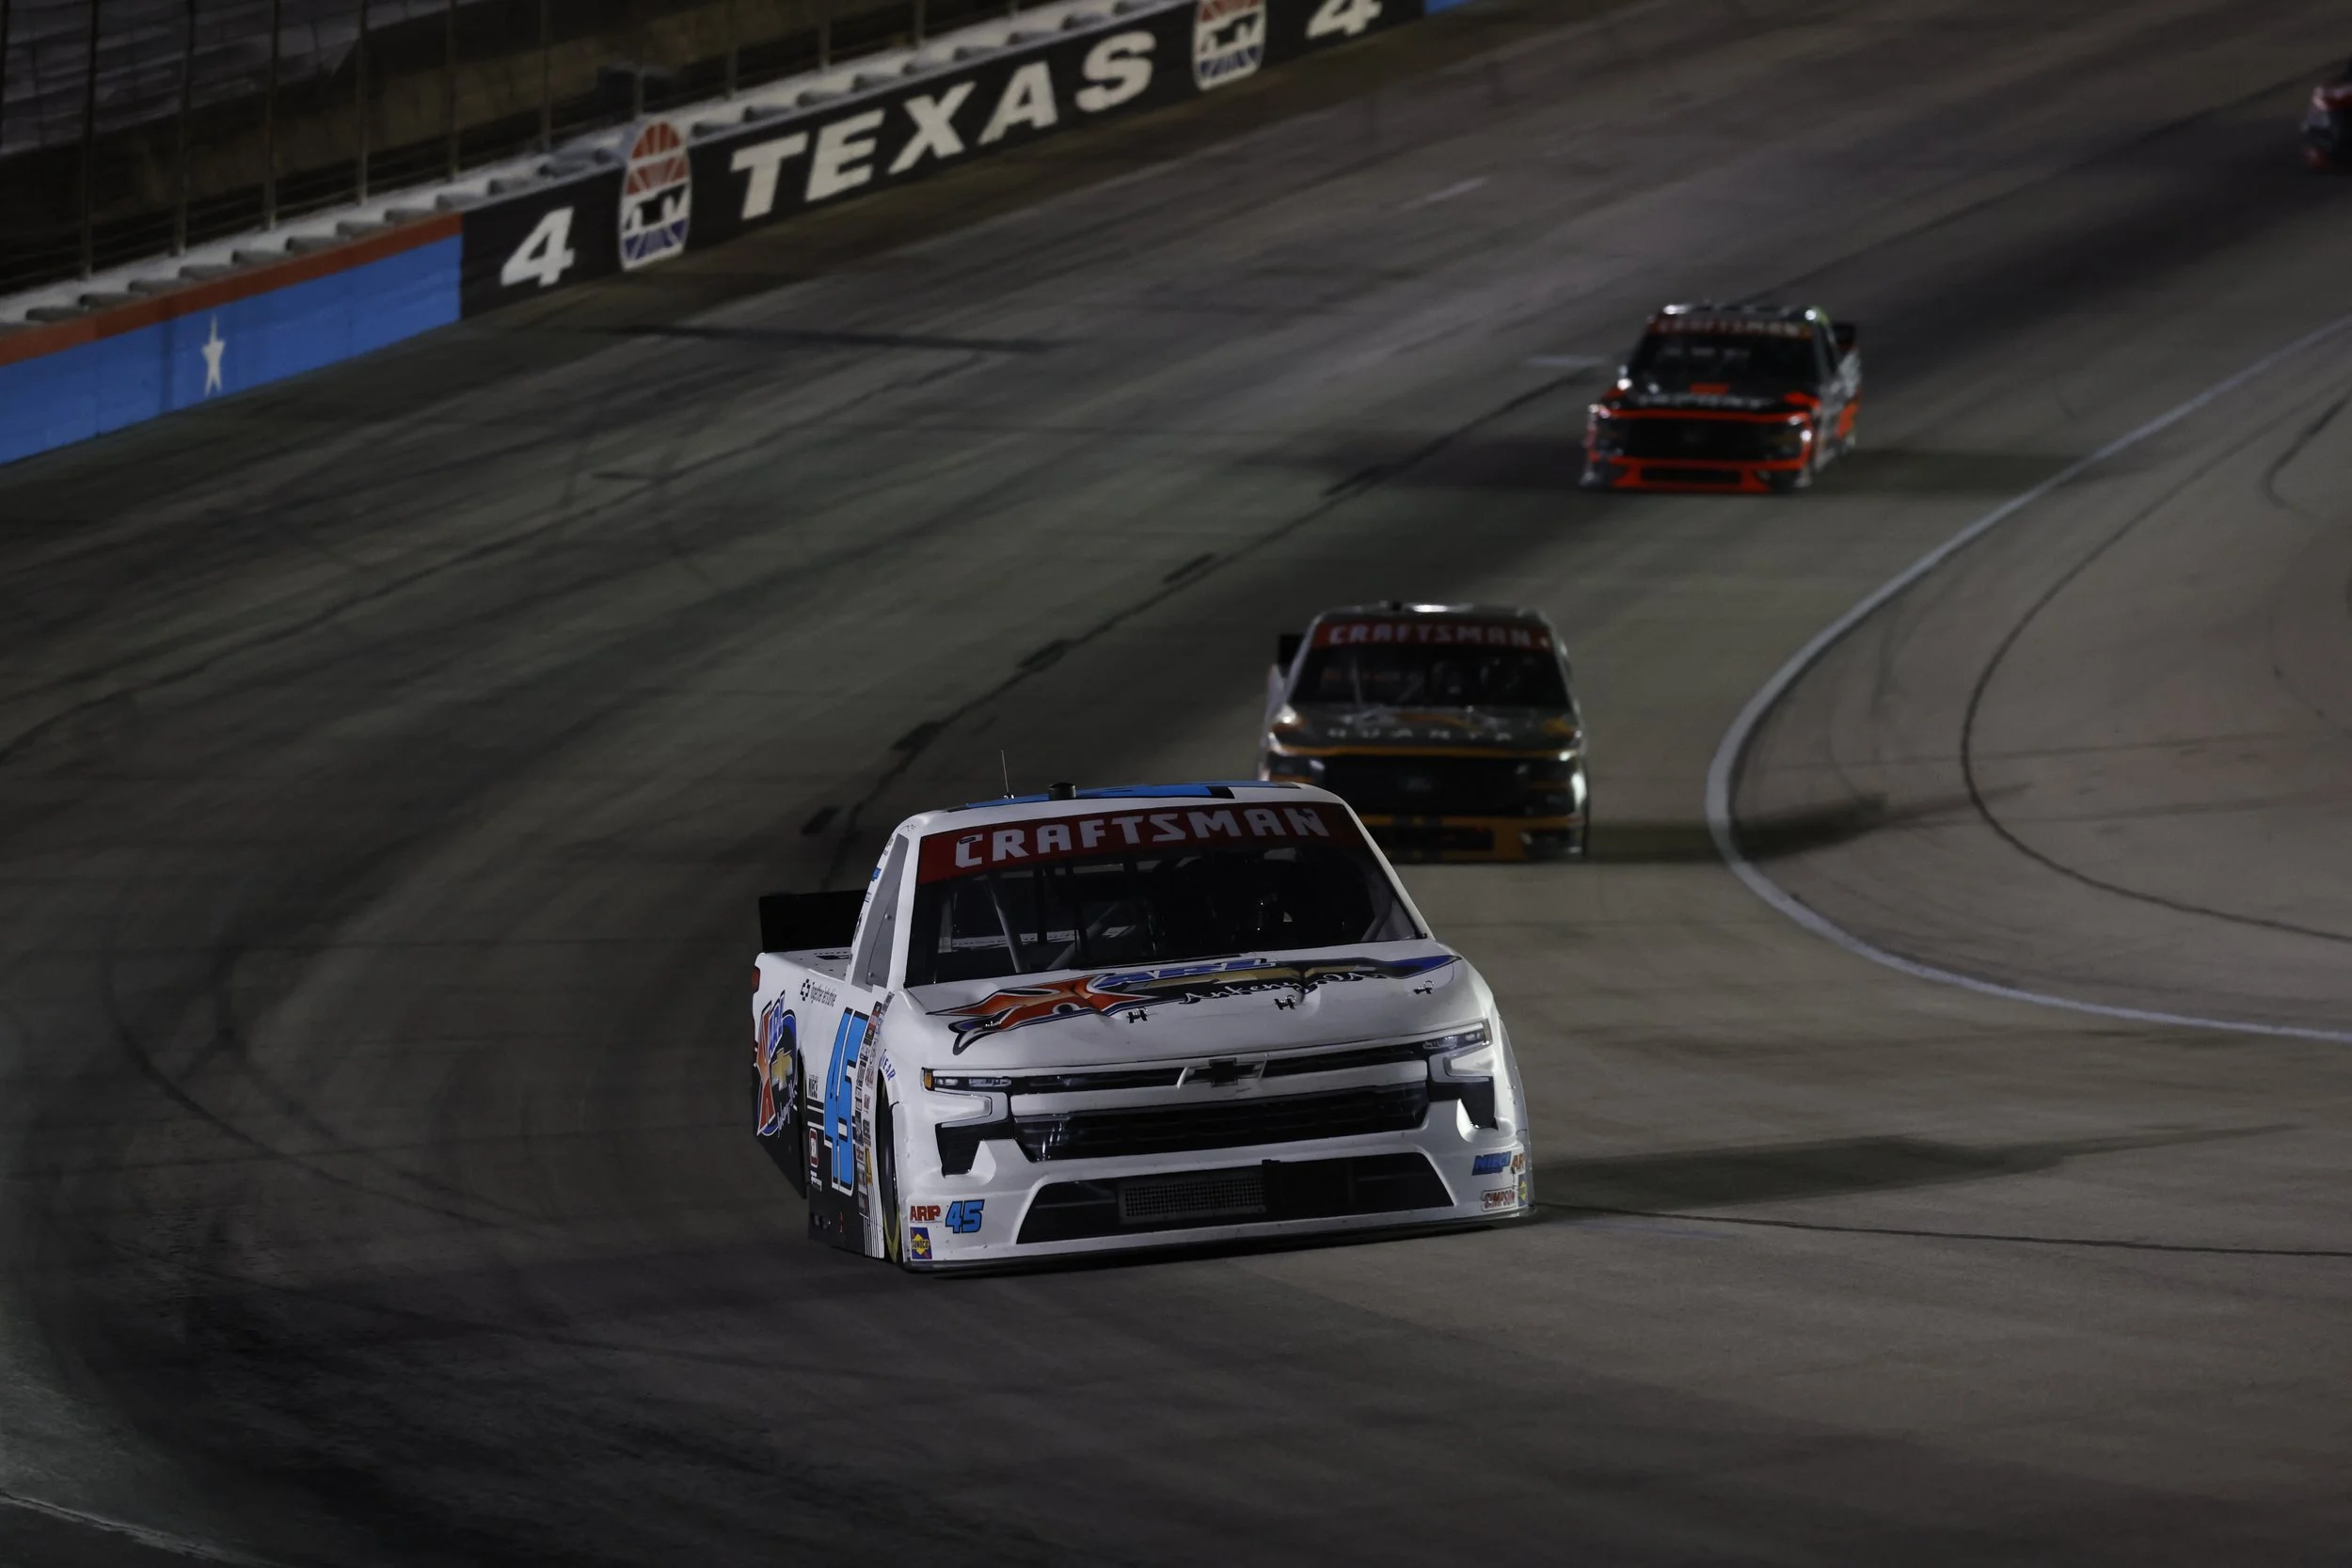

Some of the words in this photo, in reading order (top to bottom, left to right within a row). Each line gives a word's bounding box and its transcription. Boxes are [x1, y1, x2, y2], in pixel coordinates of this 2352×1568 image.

[729, 29, 1157, 221] TEXAS
[500, 206, 576, 287] 4
[1328, 623, 1532, 647] CRAFTSMAN
[954, 806, 1330, 869] CRAFTSMAN
[822, 1006, 871, 1196] 45
[910, 1205, 942, 1222] ARP
[945, 1199, 986, 1234] 45
